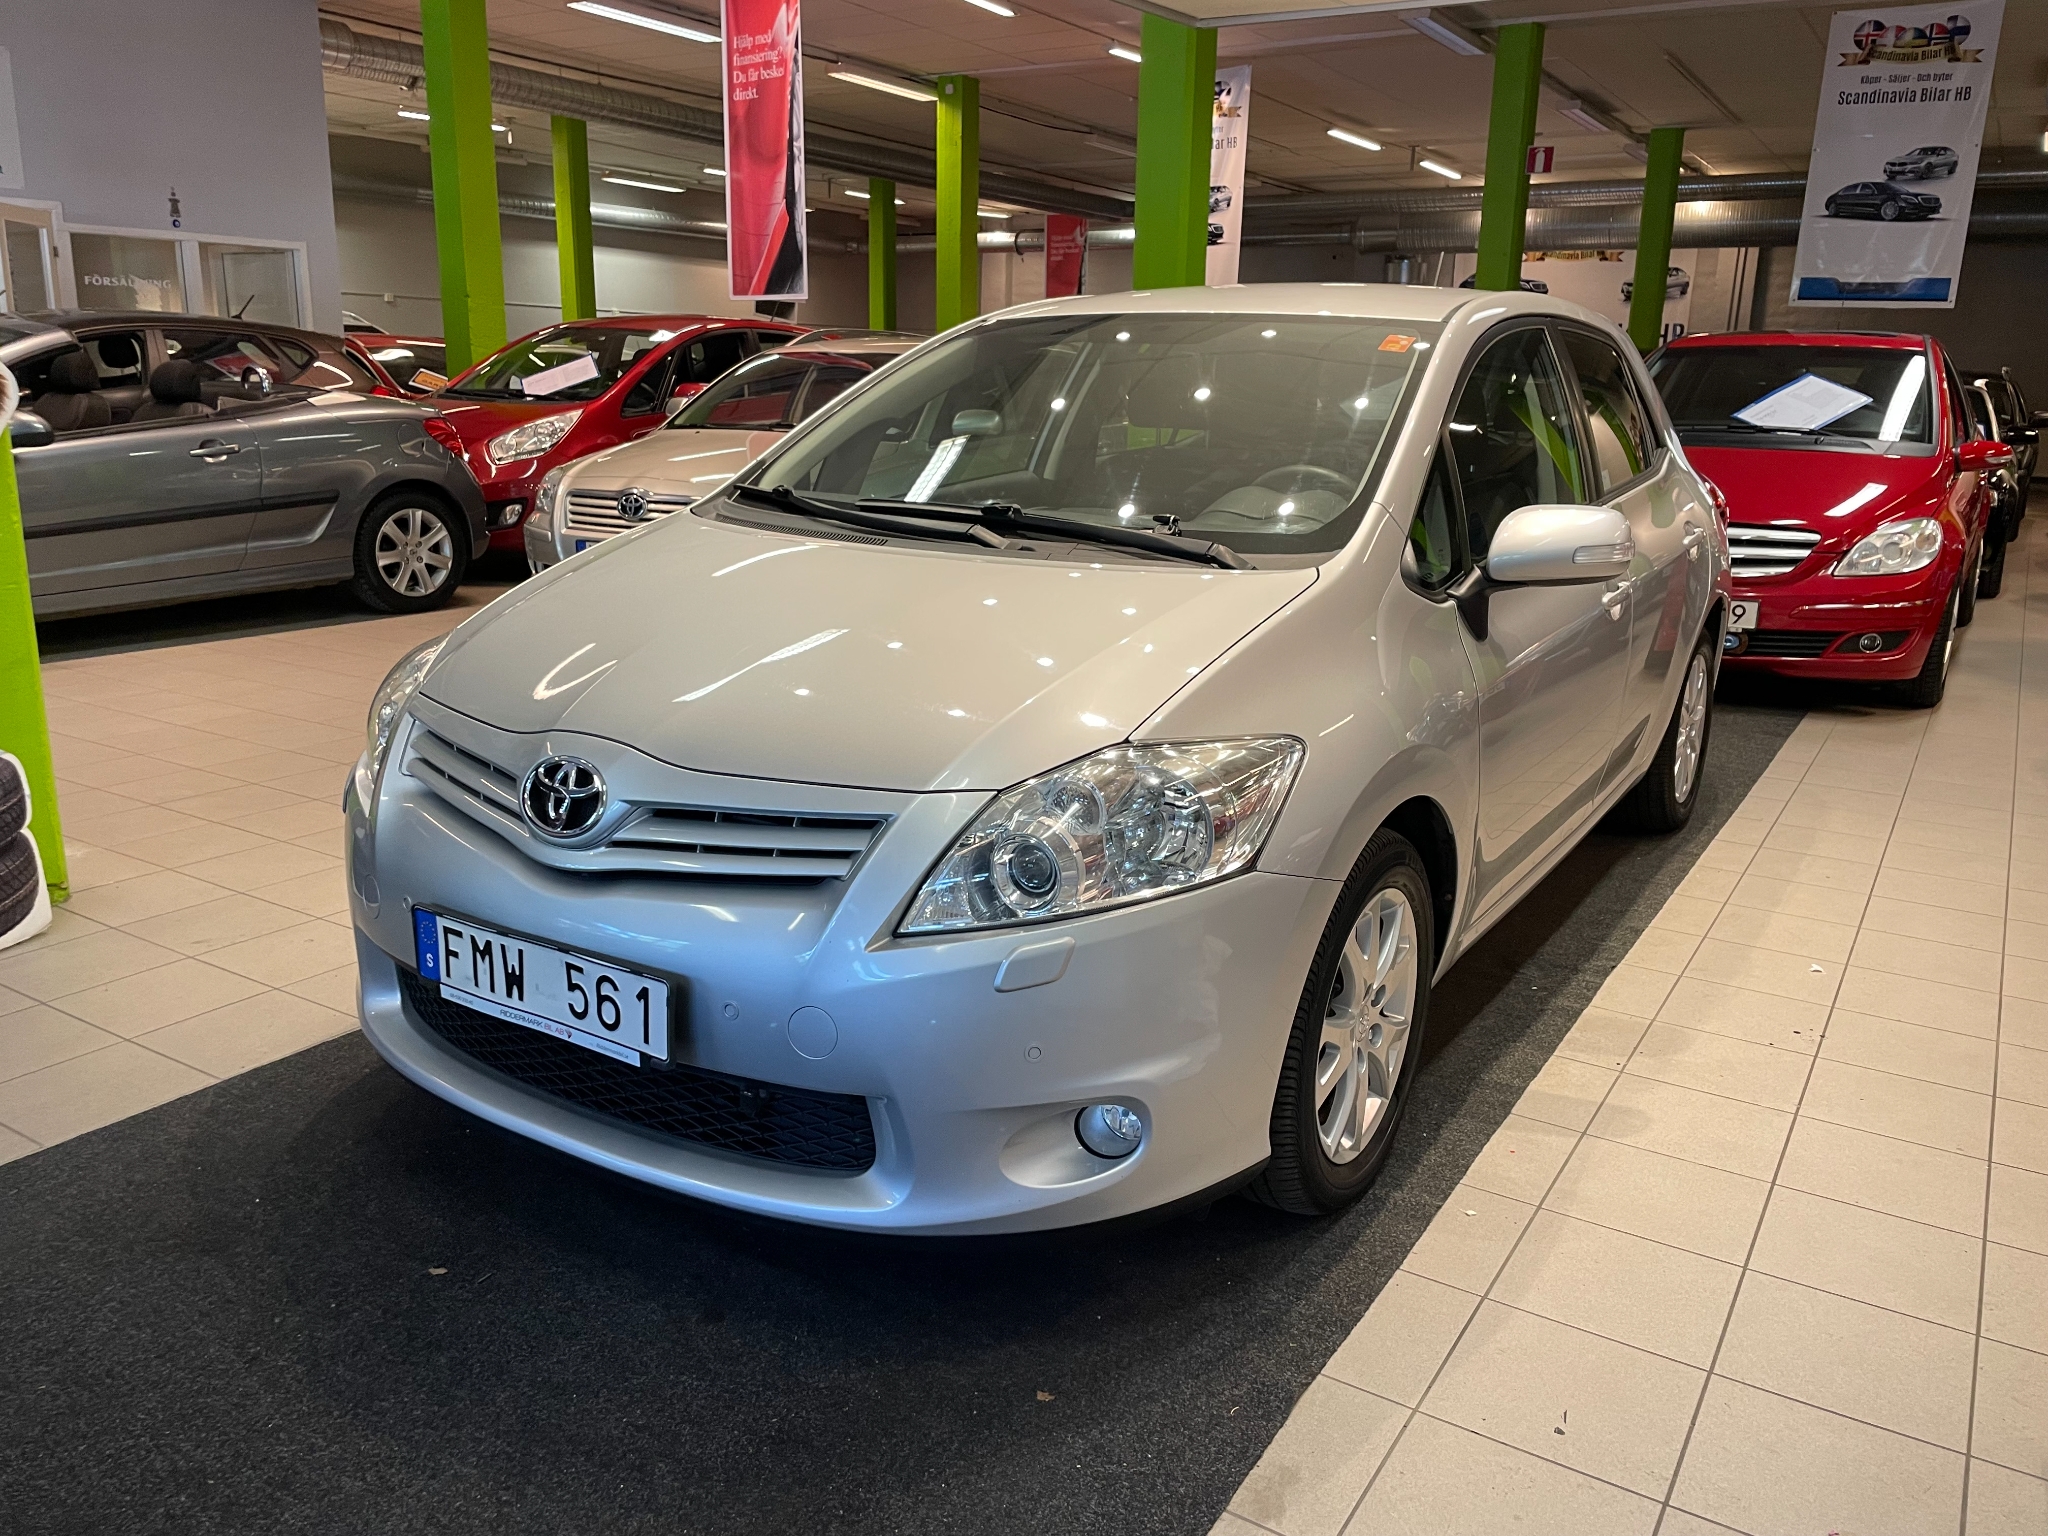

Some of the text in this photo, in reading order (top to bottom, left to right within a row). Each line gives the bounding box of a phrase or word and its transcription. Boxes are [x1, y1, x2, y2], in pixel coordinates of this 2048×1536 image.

[733, 29, 772, 51] Hjälp med
[733, 46, 783, 67] finansiering?
[1921, 48, 1942, 60] Bilar
[733, 70, 746, 83] Du
[748, 68, 759, 81] får
[1933, 72, 1953, 82] byter
[1838, 86, 1972, 105] Scandinavia Bilar HB
[1226, 136, 1238, 148] HB
[1732, 604, 1746, 624] 9
[426, 953, 434, 968] S
[443, 925, 650, 1045] FMW 561
[500, 1009, 543, 1028] RIDDERMARK
[555, 1027, 565, 1035] AB
